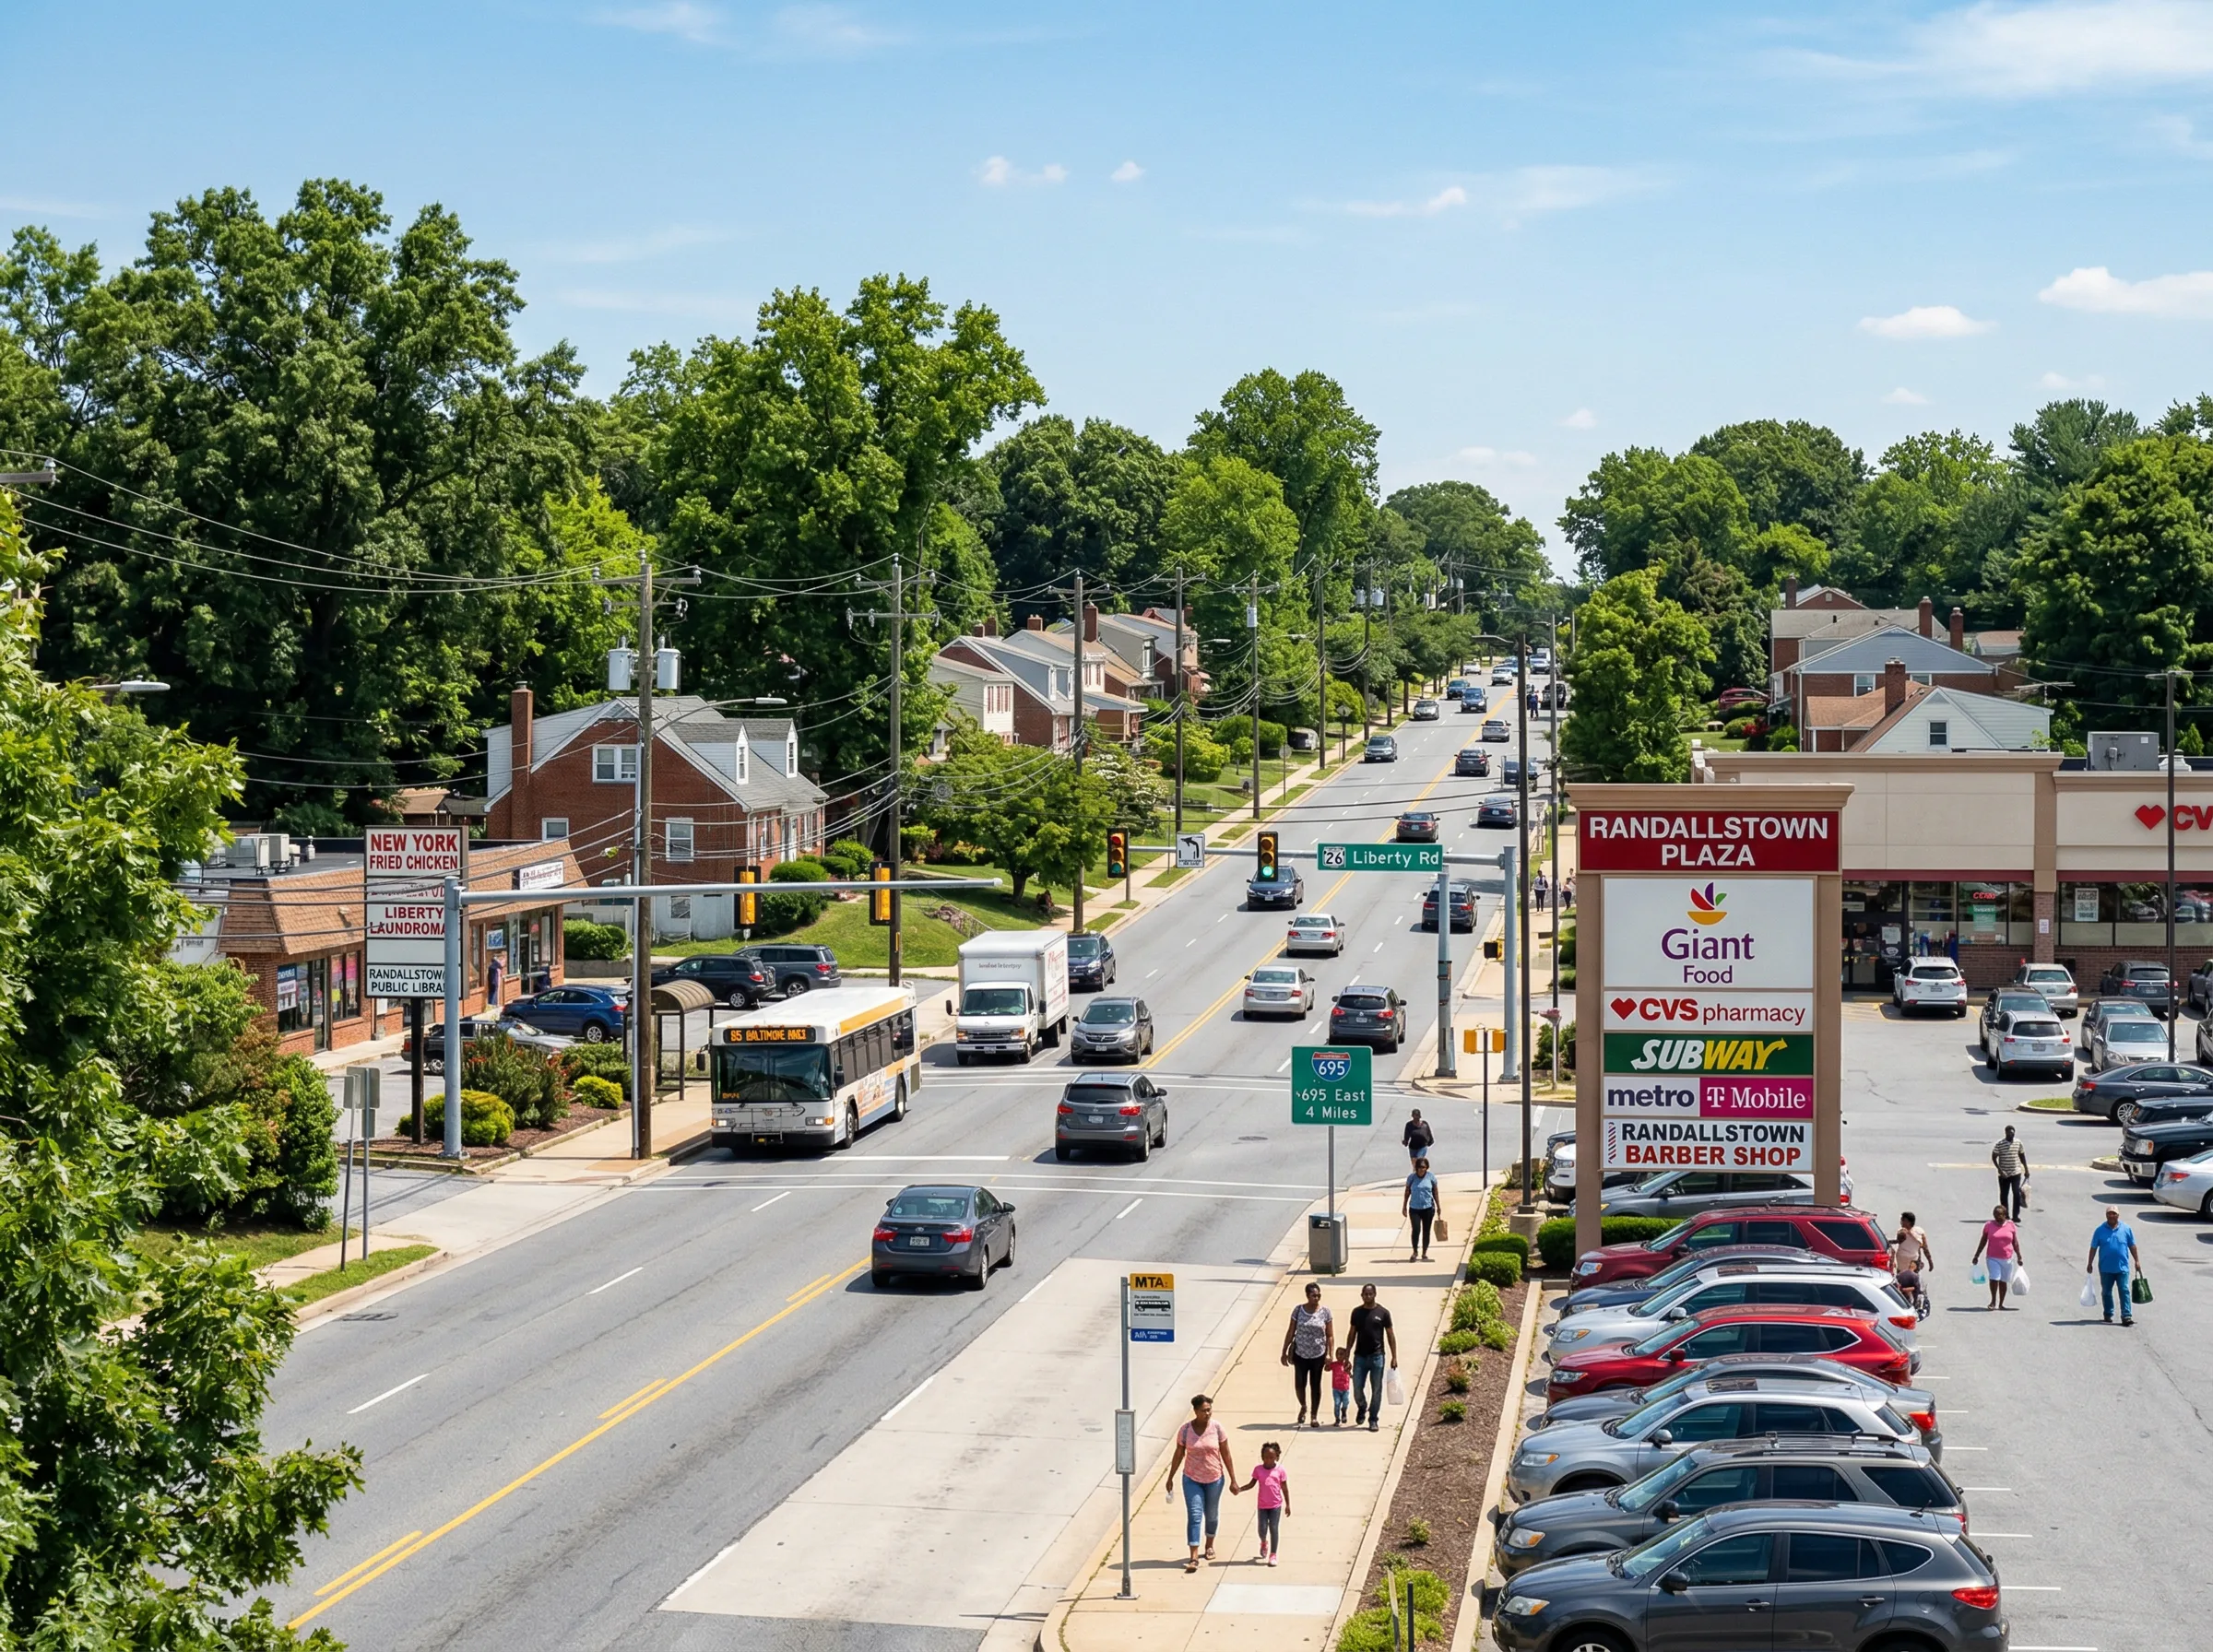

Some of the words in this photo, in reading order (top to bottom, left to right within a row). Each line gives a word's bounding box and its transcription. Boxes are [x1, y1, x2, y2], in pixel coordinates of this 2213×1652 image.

[1590, 817, 1828, 839] RANDALLSTOWN
[371, 833, 407, 852] NEW
[412, 833, 457, 852] YORK
[370, 855, 402, 869] FRIED
[406, 855, 458, 870] CHICKEN
[1326, 852, 1343, 865] 26
[1353, 851, 1412, 867] Liberty
[1420, 851, 1439, 865] Rd
[1662, 844, 1756, 866] PLAZA
[385, 907, 444, 919] LIBERTY
[1661, 928, 1755, 960] Giant
[1684, 965, 1733, 984] Food
[371, 981, 408, 992] PUBLIC
[412, 982, 445, 993] LIBRA
[1639, 997, 1698, 1021] CVS
[1703, 1004, 1806, 1025] pharmacy
[1631, 1037, 1788, 1069] SUBWAY
[1319, 1060, 1345, 1076] 695
[1335, 1089, 1366, 1102] East
[1608, 1085, 1695, 1107] metro
[1731, 1087, 1806, 1108] Mobile
[1306, 1105, 1315, 1118] 4
[1322, 1105, 1357, 1119] Miles
[1622, 1123, 1805, 1142] RANDALLSTOWN
[1626, 1145, 1725, 1164] BARBER
[1734, 1146, 1801, 1165] SHOP
[1135, 1276, 1164, 1288] MTA
